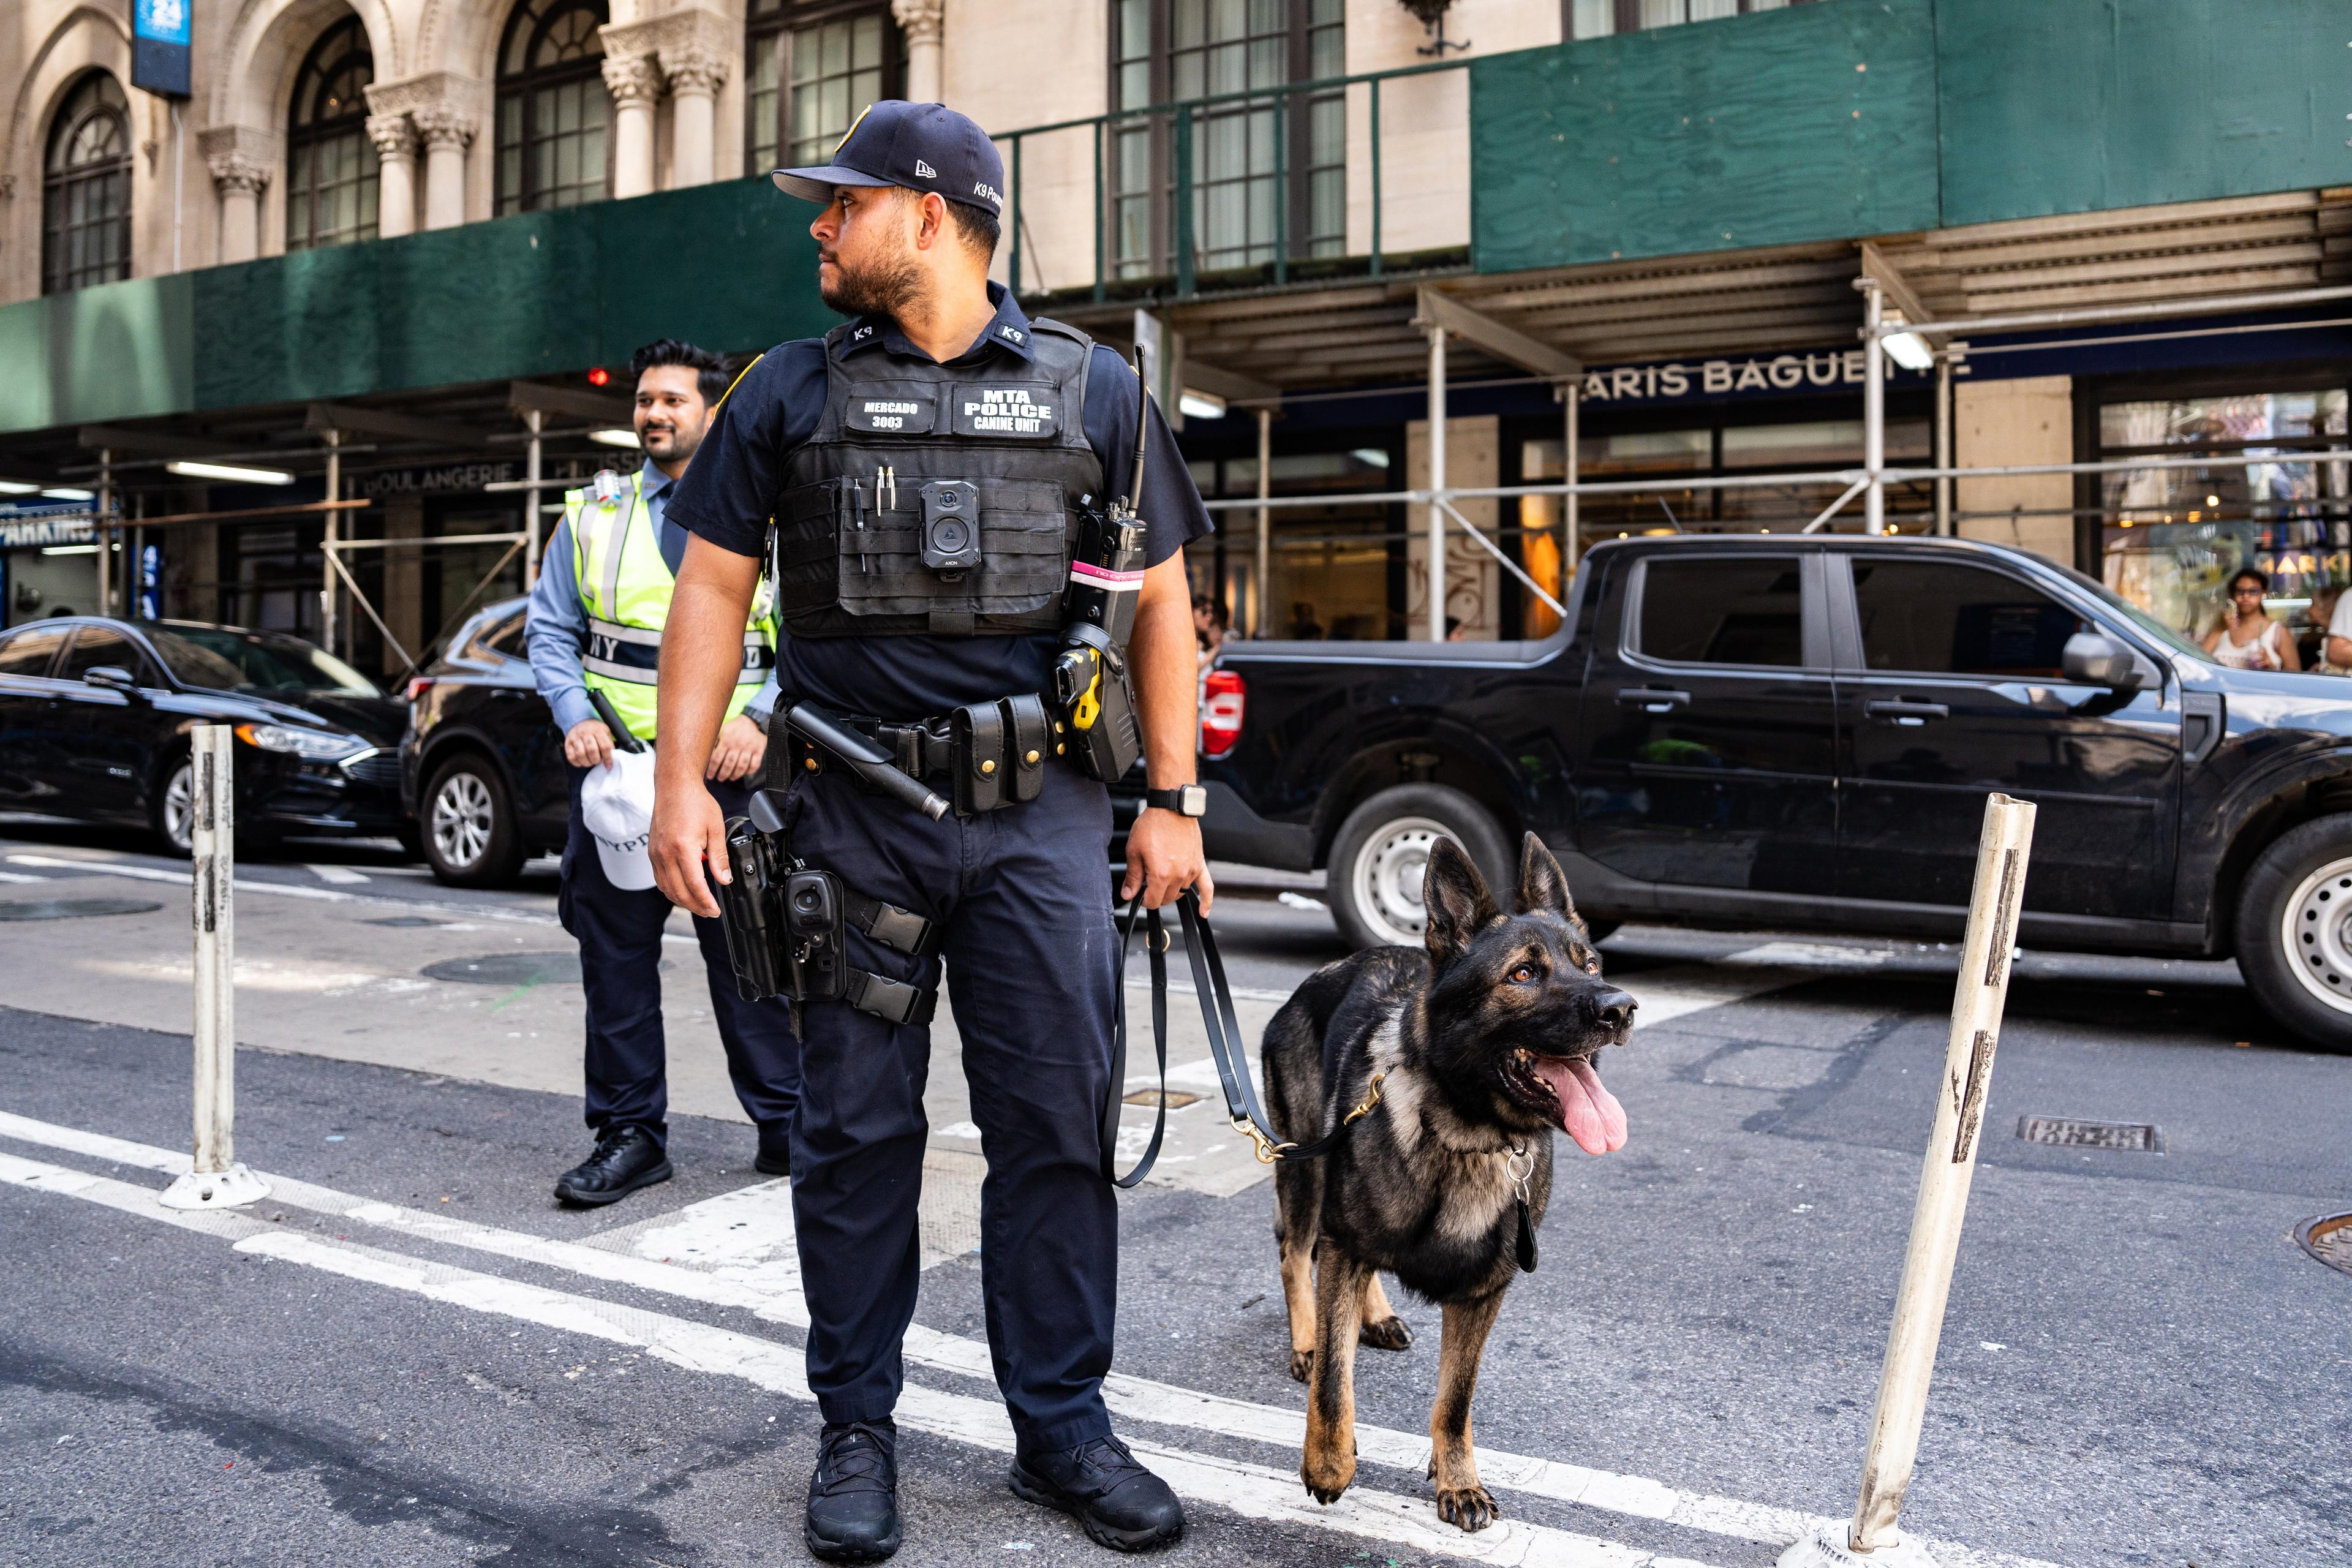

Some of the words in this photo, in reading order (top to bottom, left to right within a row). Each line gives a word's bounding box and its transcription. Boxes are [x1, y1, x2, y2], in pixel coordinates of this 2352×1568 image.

[974, 181, 987, 197] K9
[854, 326, 872, 341] K9
[1001, 326, 1023, 342] K9
[1554, 364, 1689, 403] ARIS
[983, 390, 1031, 404] MTA
[864, 402, 918, 415] MERCADO
[964, 402, 1052, 419] POLICE
[872, 415, 903, 429] 3003
[974, 416, 1013, 431] CANINE
[1014, 417, 1041, 432] UNIT
[589, 633, 619, 662] NY
